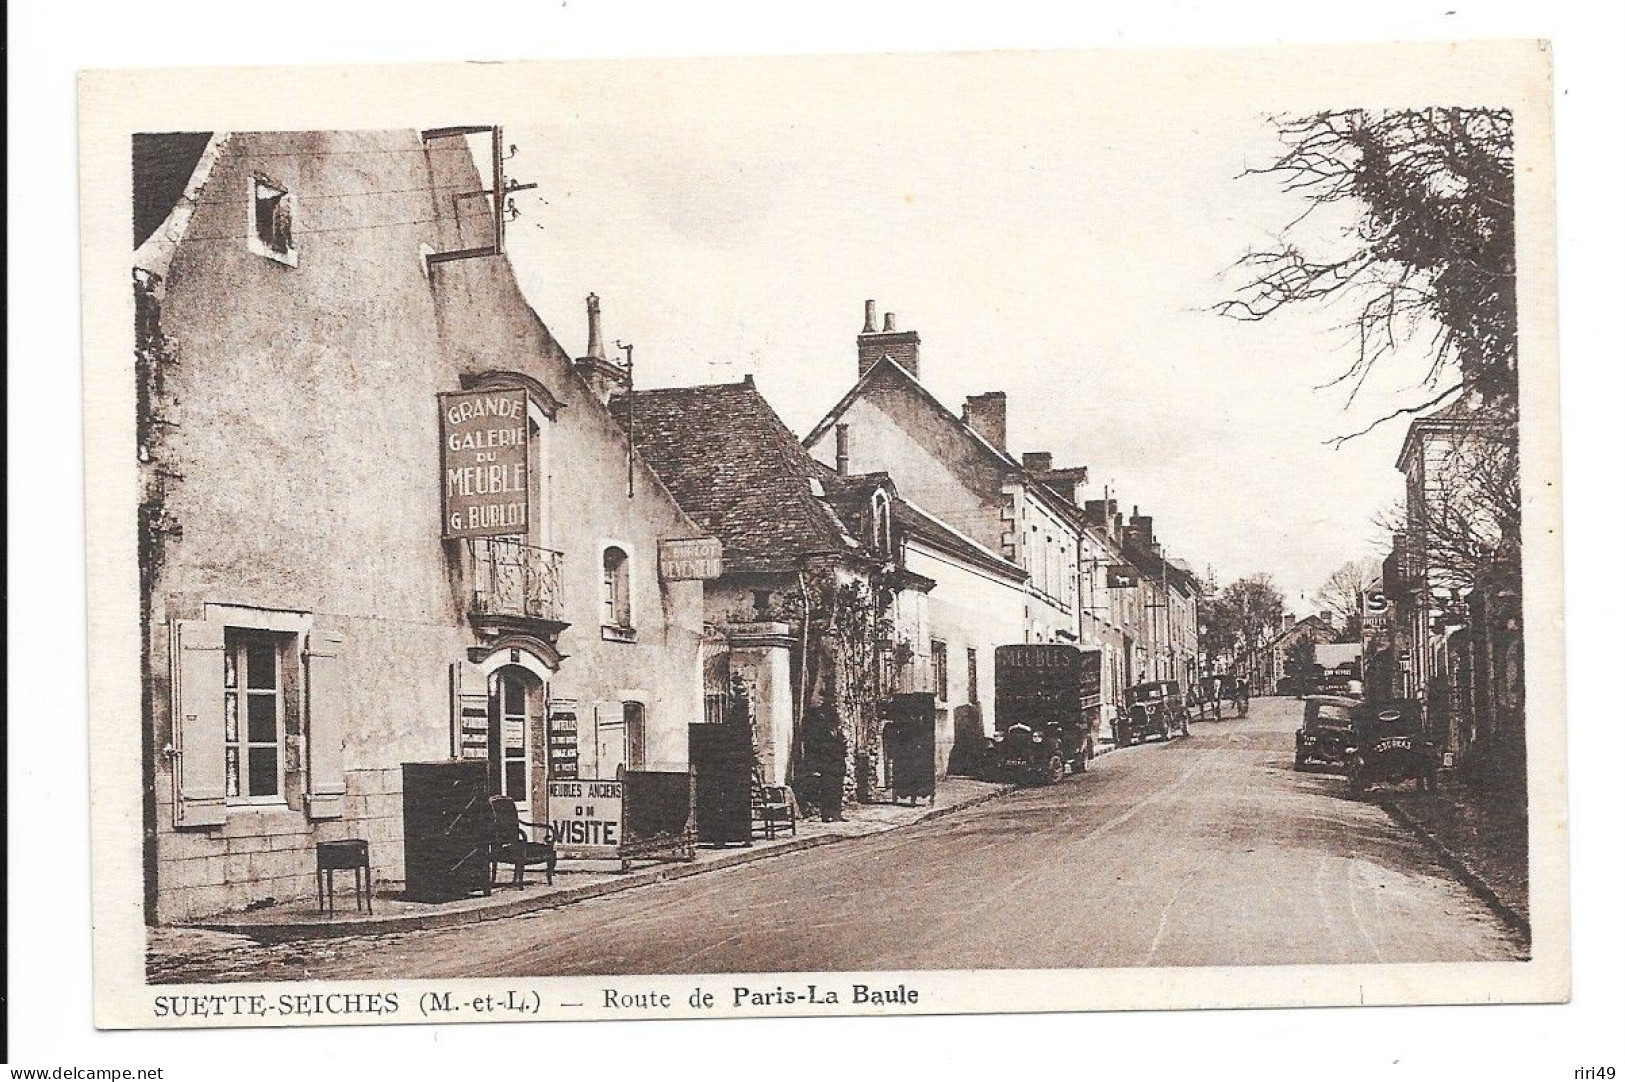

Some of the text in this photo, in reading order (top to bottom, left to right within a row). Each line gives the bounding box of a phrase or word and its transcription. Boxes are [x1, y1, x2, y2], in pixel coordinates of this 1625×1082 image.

[448, 398, 523, 424] GRANDE
[448, 426, 525, 451] GALERIE
[476, 452, 496, 462] DU
[448, 463, 526, 497] MEUBLE
[468, 502, 527, 529] BURLOT
[588, 783, 622, 799] ANCIENS
[552, 820, 618, 846] VISITE
[154, 992, 399, 1017] SUETTE-SEICHES
[603, 989, 671, 1009] Route
[689, 987, 714, 1009] de
[733, 985, 839, 1007] Paris-La
[853, 984, 919, 1006] Baule
